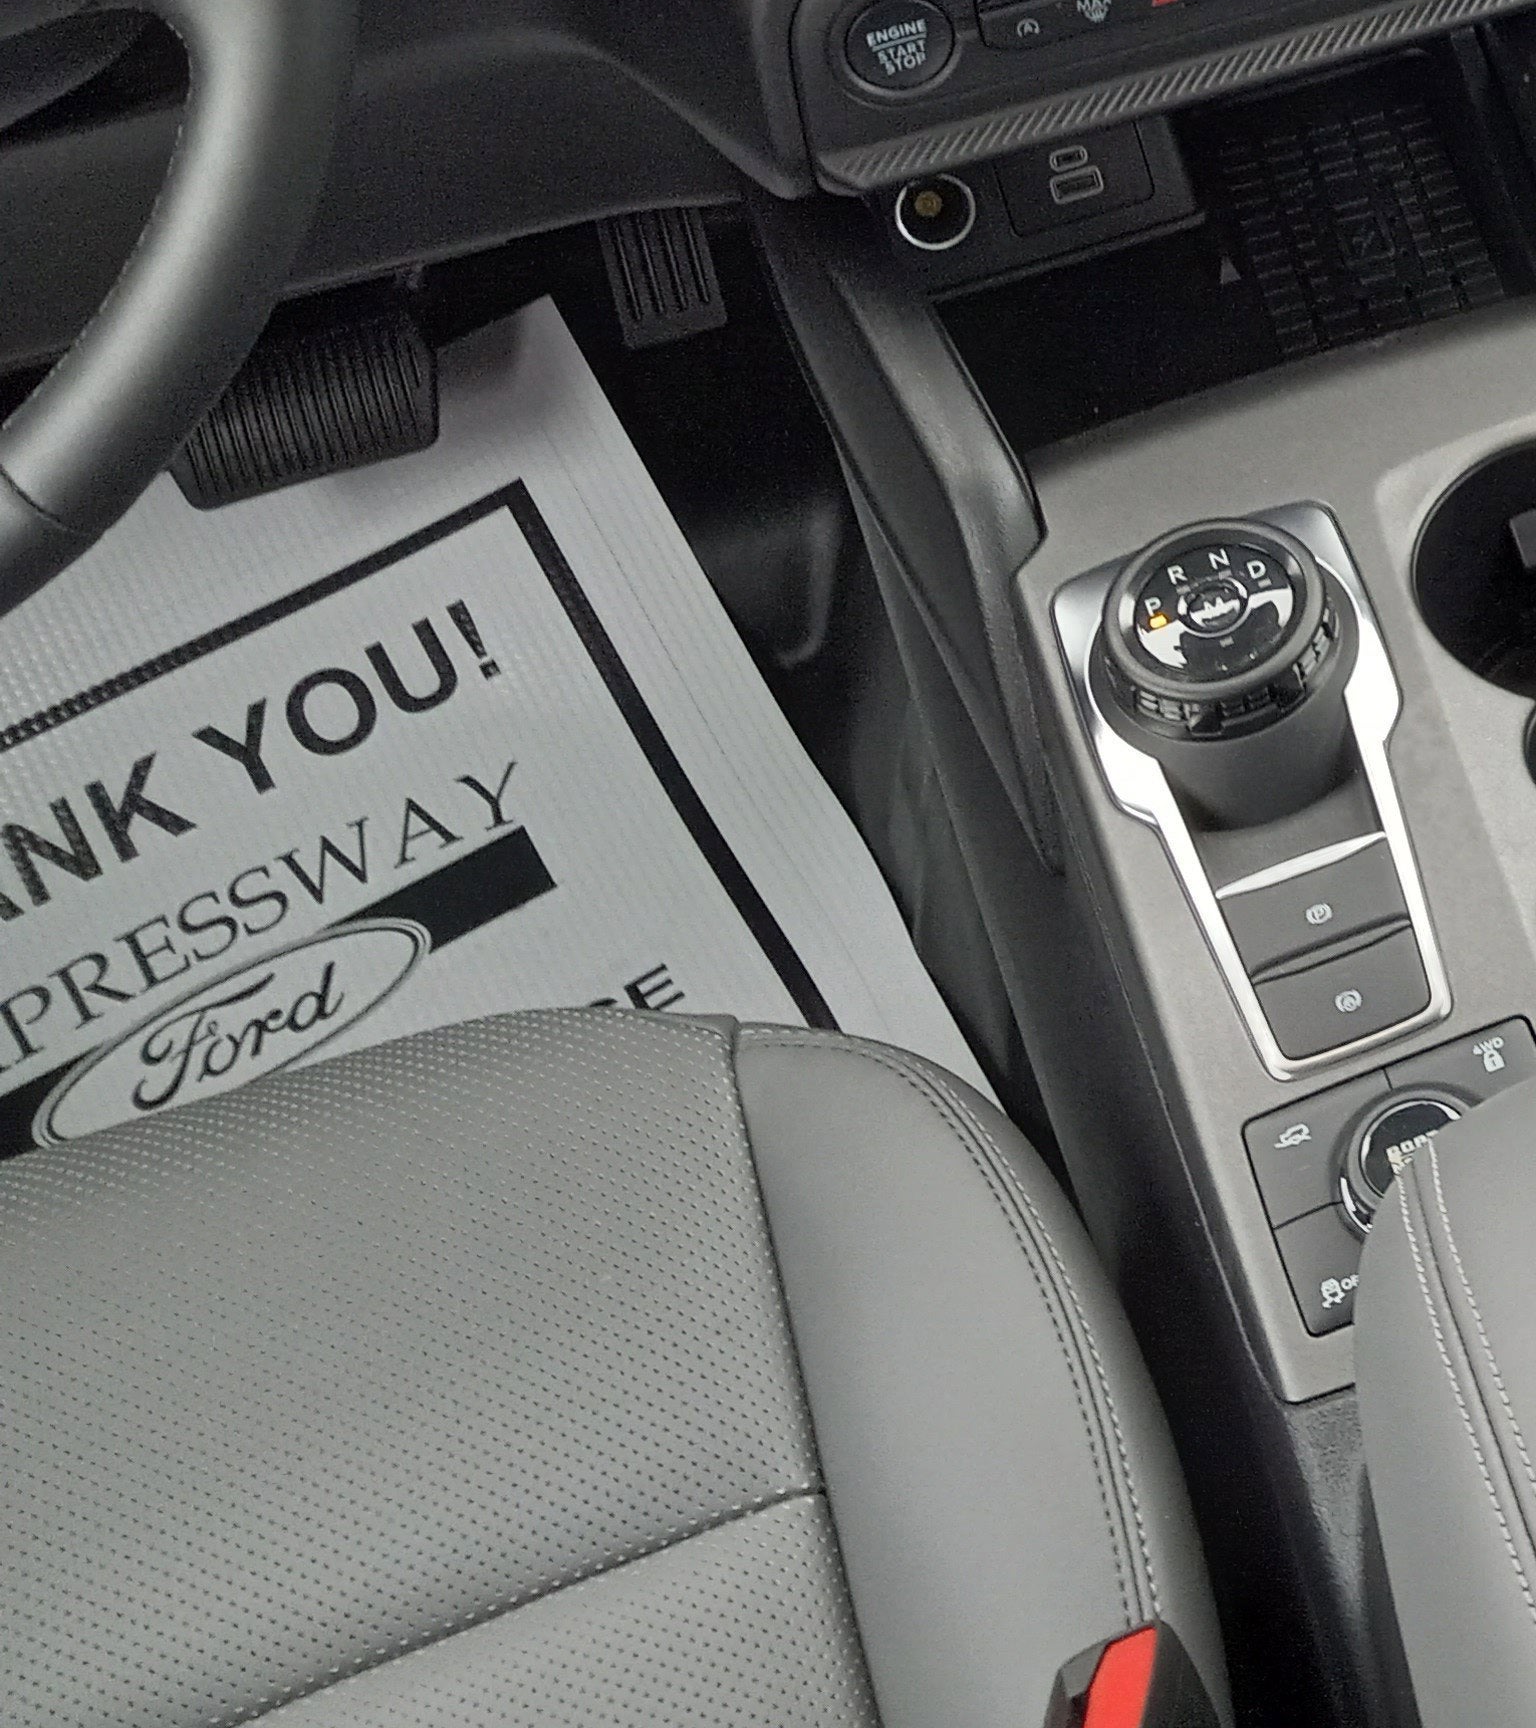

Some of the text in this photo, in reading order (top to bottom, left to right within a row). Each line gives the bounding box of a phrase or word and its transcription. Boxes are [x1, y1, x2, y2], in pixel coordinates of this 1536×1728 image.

[866, 19, 928, 48] ENGINE
[877, 38, 927, 64] START
[884, 50, 927, 76] STOP
[1208, 548, 1231, 570] N
[1246, 559, 1267, 580] D
[1167, 564, 1188, 585] R
[1144, 596, 1162, 617] P
[0, 599, 502, 922] NK YOU!
[132, 961, 344, 1111] Ford
[1473, 1037, 1504, 1055] 4WD
